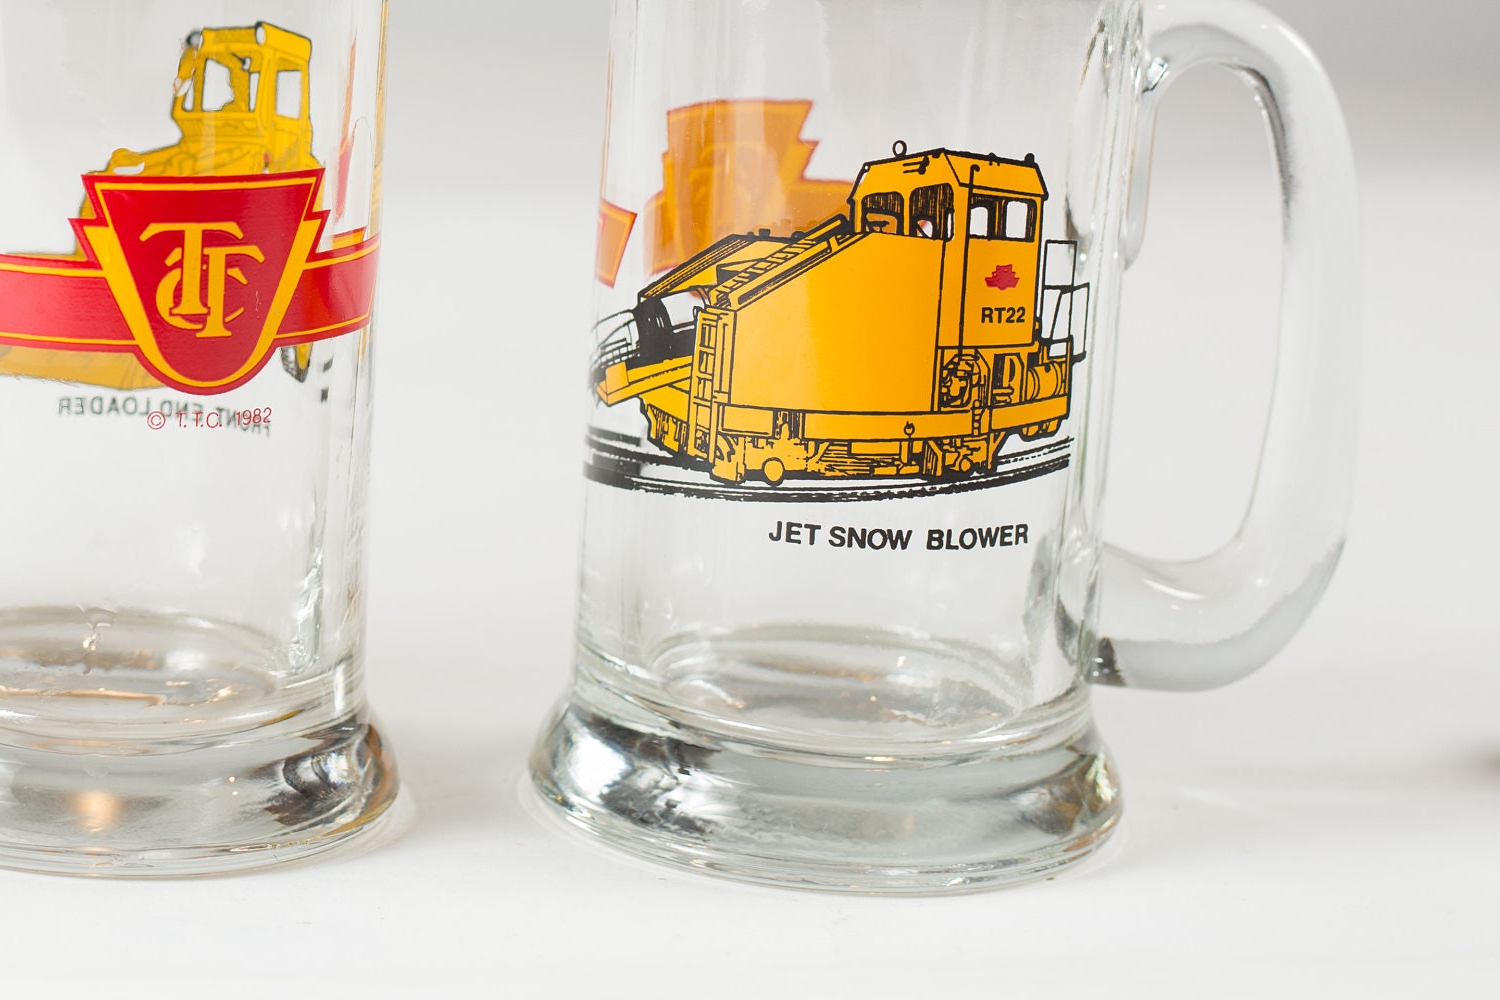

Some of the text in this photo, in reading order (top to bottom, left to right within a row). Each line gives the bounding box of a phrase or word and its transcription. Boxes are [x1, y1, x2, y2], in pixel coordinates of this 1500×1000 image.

[981, 307, 1027, 324] RT22
[236, 406, 273, 426] 1982
[768, 520, 1029, 551] JET SNOW BLOWER
